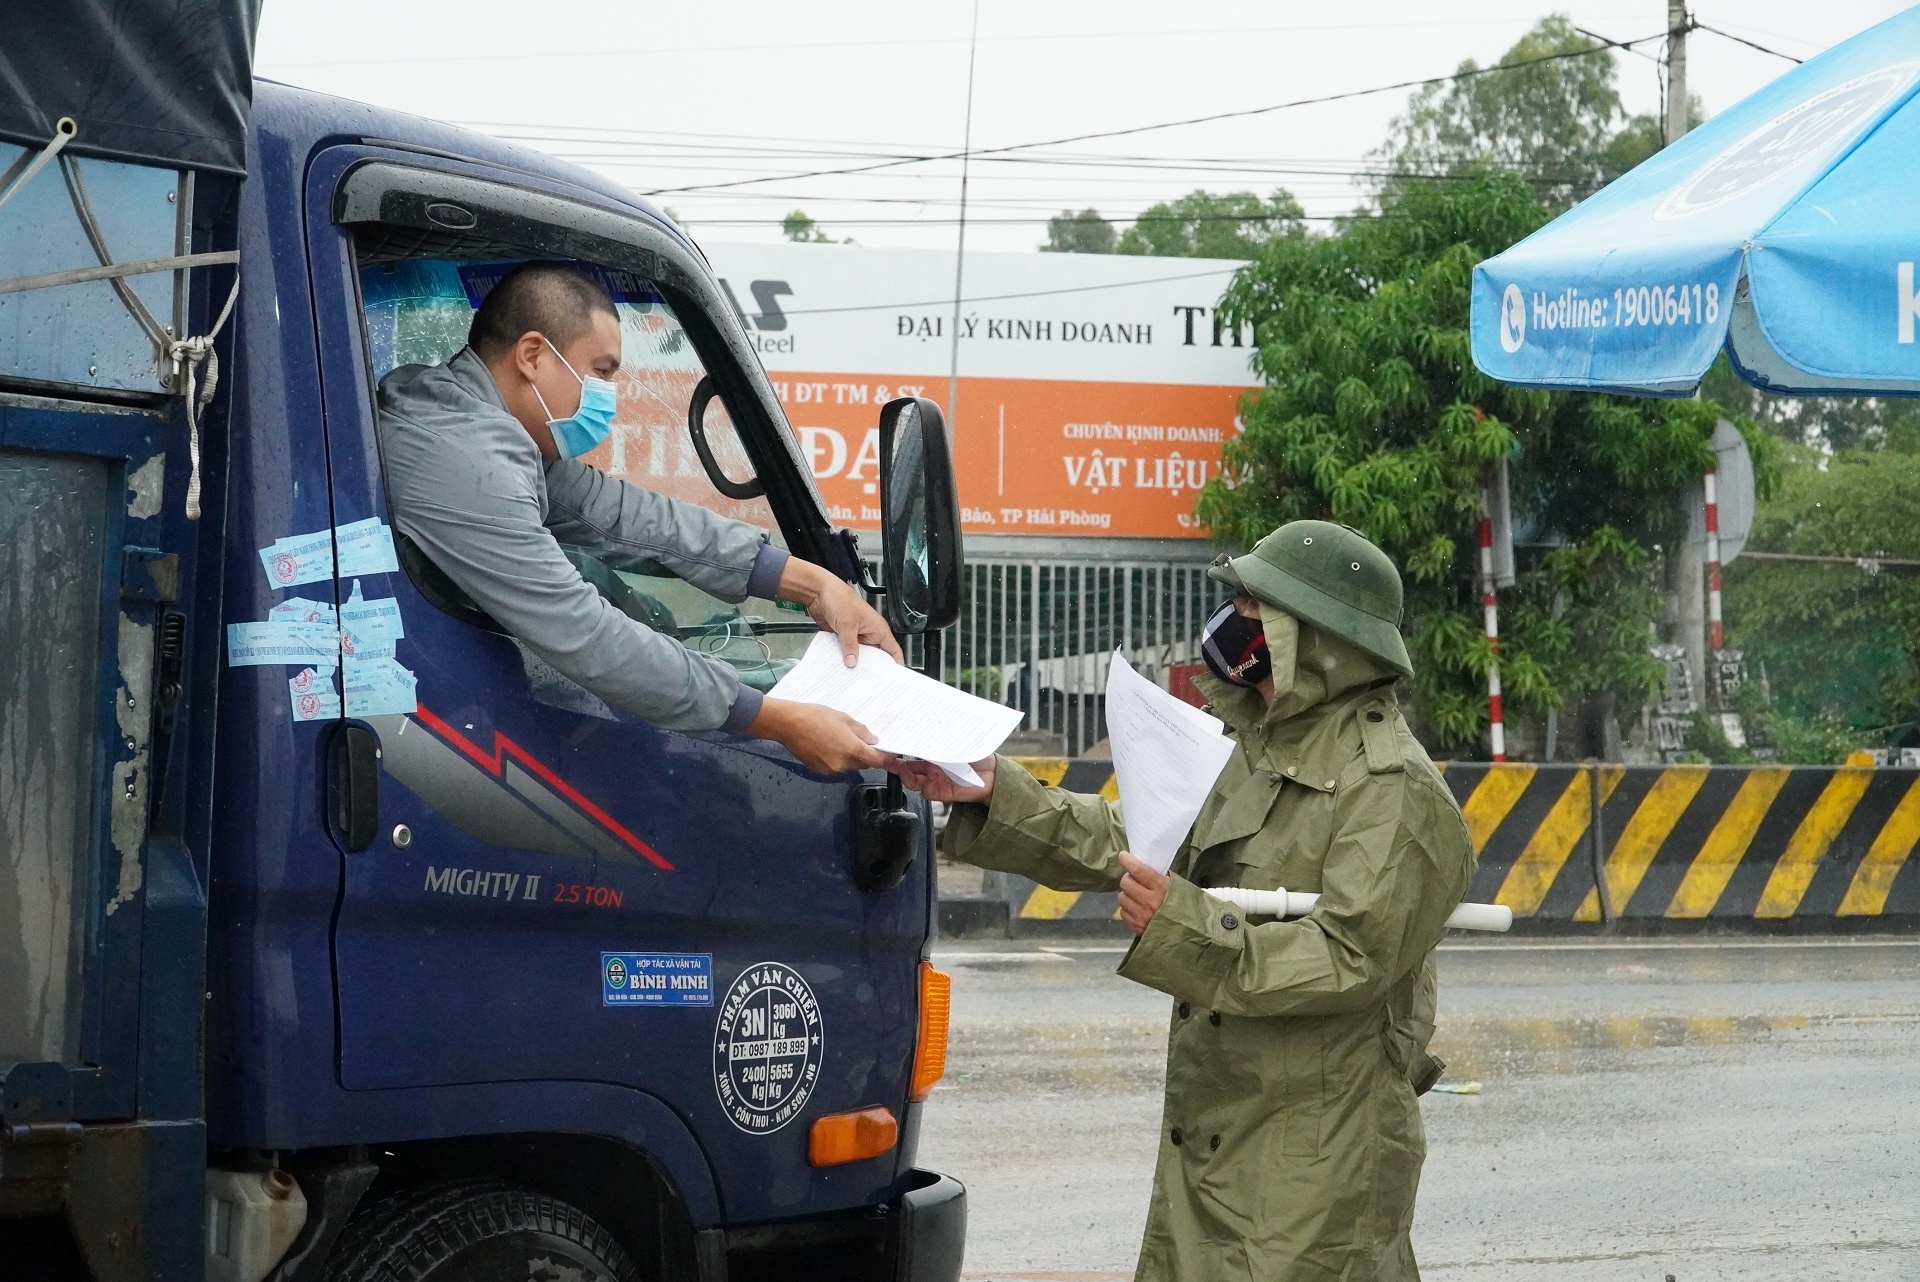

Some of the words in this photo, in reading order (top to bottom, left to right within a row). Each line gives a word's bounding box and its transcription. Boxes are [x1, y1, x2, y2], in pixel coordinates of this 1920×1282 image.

[1532, 288, 1608, 330] Hotline:
[1613, 282, 1719, 327] 19006418
[897, 315, 943, 342] ĐẠI
[988, 318, 1052, 341] KINH
[1062, 321, 1152, 344] DOANH
[1173, 305, 1259, 349] TH
[832, 383, 868, 404] TM
[1063, 421, 1123, 439] CHUYÊN
[1167, 426, 1224, 442] DOANH:
[1063, 448, 1128, 495] VẬT
[1135, 450, 1208, 496] LIỆU
[1001, 508, 1023, 524] TP
[1059, 509, 1111, 528] Phòng
[423, 866, 520, 902] MIGHTY
[584, 885, 625, 908] TON
[652, 958, 665, 968] TÁC
[630, 970, 667, 990] BÌNH
[670, 975, 709, 990] MINH
[721, 980, 751, 1033] PHẠM
[751, 966, 782, 987] VĂN
[773, 1003, 797, 1020] 3060
[741, 1007, 765, 1038] 3N
[773, 1021, 786, 1039] Kg
[748, 1042, 770, 1057] 0987
[773, 1041, 788, 1055] 189
[790, 1039, 806, 1054] 899
[742, 1065, 766, 1083] 2400
[769, 1063, 794, 1081] 5655
[726, 1095, 735, 1107] 5
[776, 1105, 792, 1124] KIM
[805, 1063, 816, 1081] NB
[752, 1083, 765, 1101] Kg
[768, 1081, 782, 1099] Kg
